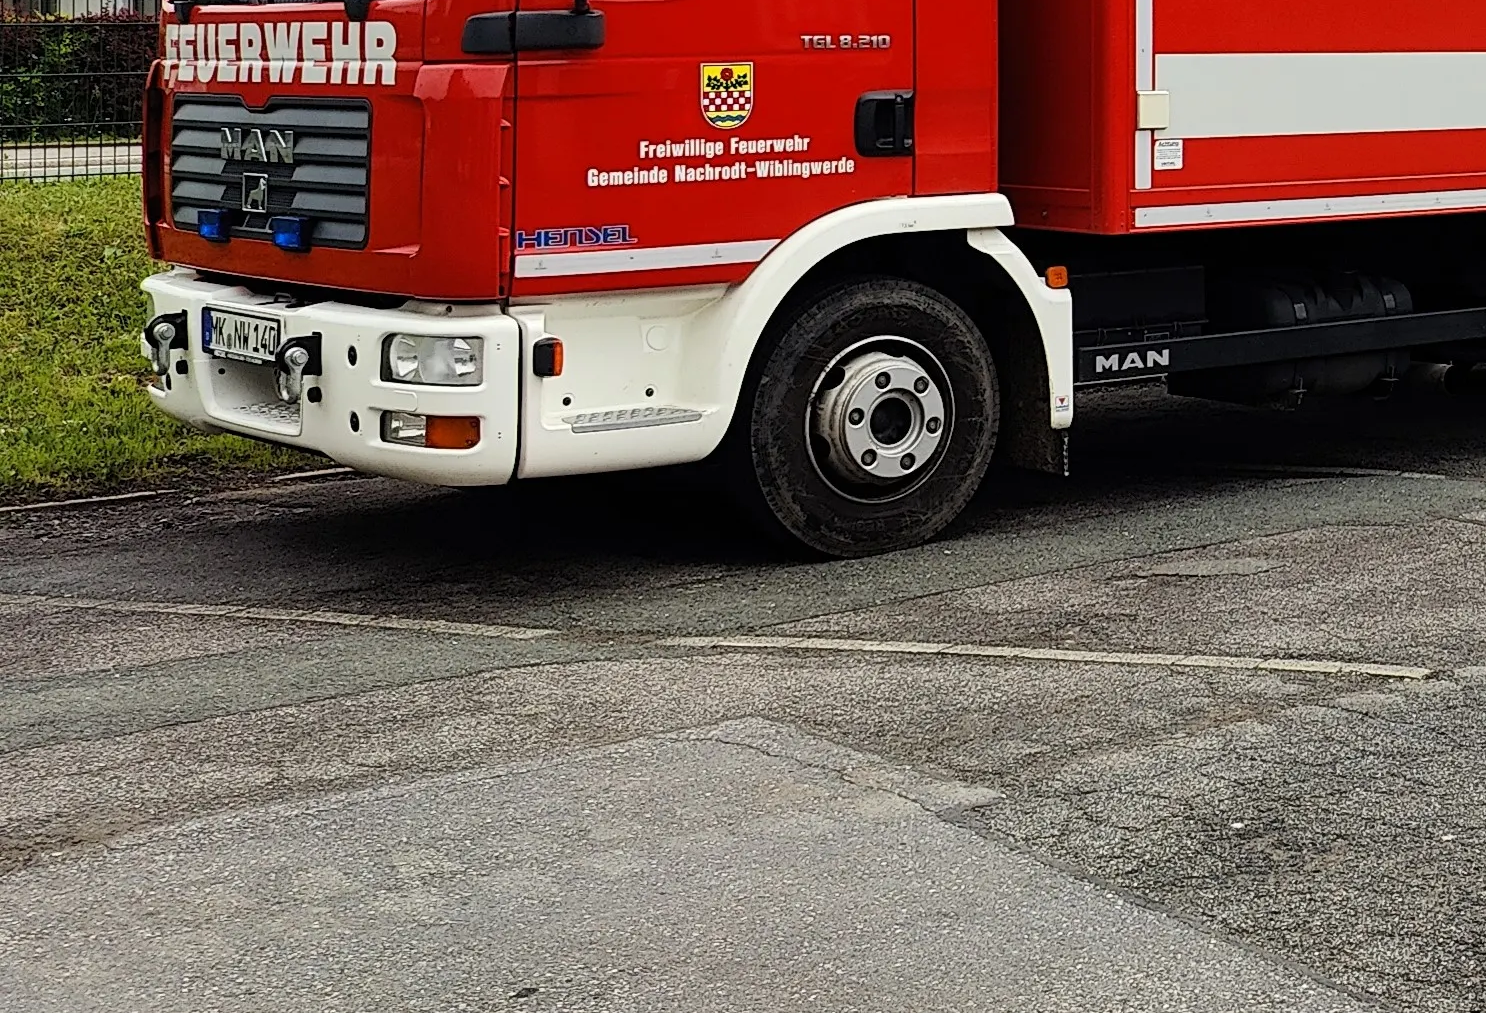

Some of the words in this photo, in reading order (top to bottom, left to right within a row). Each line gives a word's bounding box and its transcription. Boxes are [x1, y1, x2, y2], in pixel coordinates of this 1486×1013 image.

[164, 21, 397, 86] FEUERWEHR
[800, 34, 836, 49] TGL
[839, 34, 891, 49] 8.210
[220, 127, 294, 164] MAN
[639, 139, 724, 159] Freiwillige
[730, 135, 811, 155] Feuerwehr
[587, 166, 668, 187] Gemeinde
[674, 157, 855, 183] Nachrodt-Wiblingwerde
[516, 224, 638, 250] HENSEL
[212, 316, 227, 347] MK
[233, 319, 251, 351] NW
[252, 323, 277, 356] 140
[1095, 349, 1170, 373] MAN
